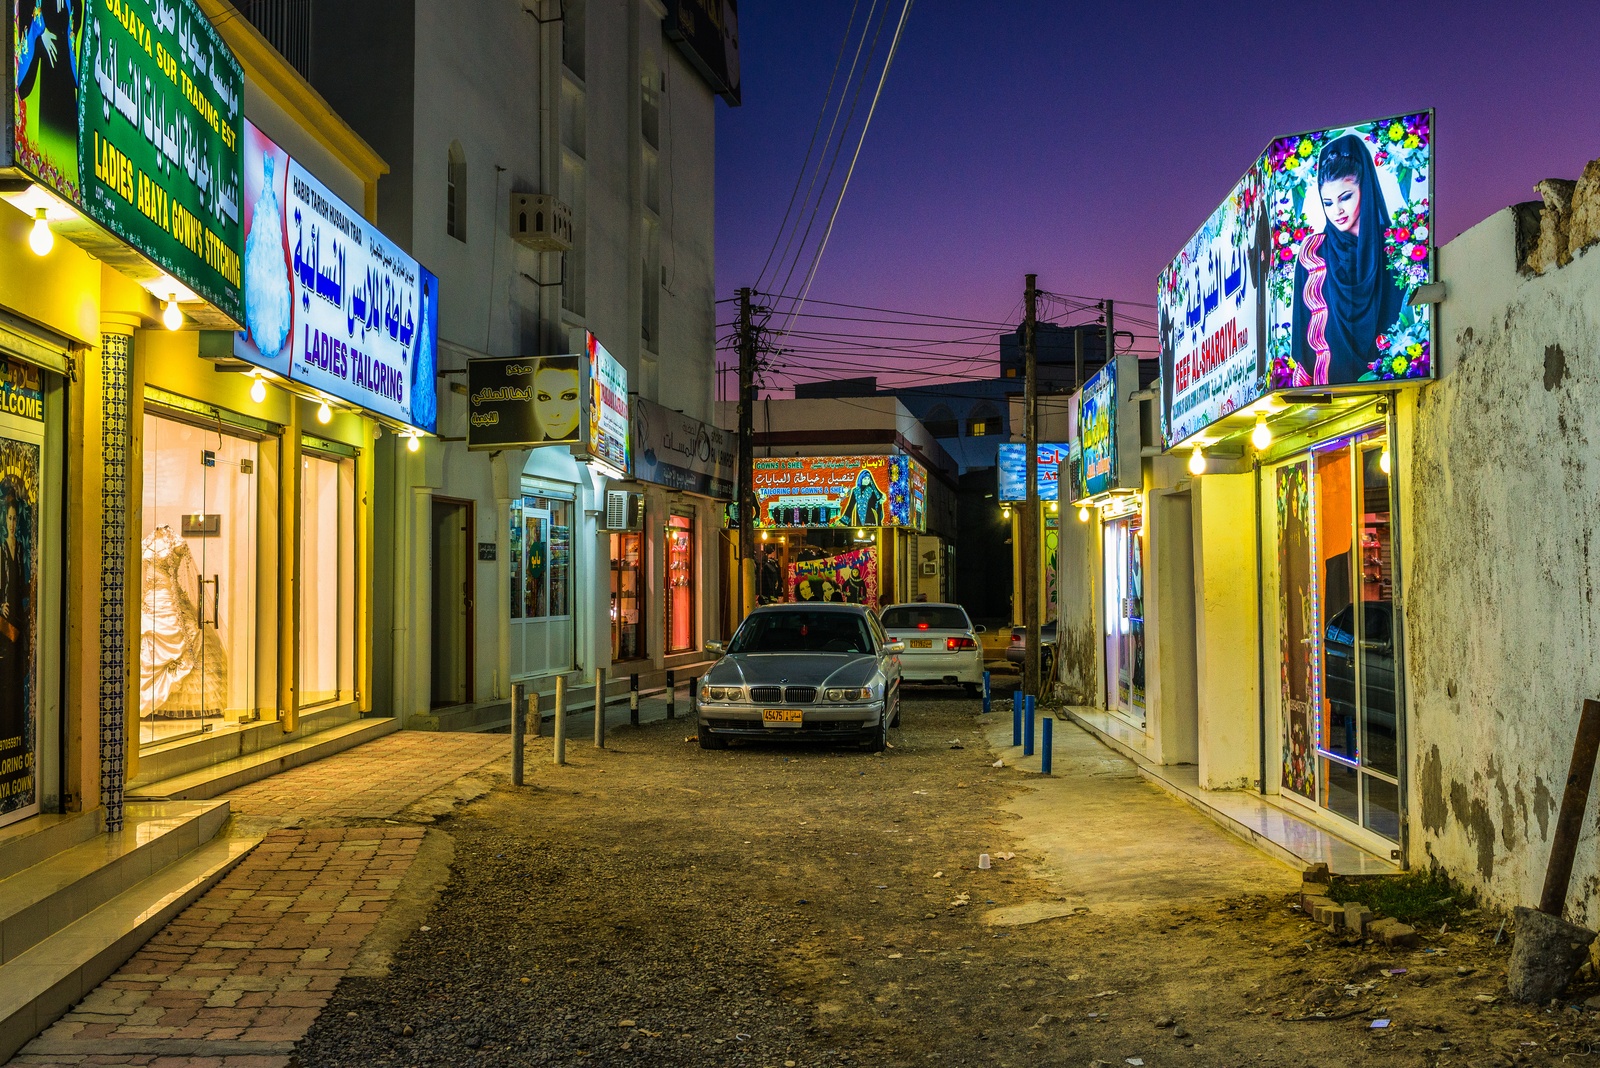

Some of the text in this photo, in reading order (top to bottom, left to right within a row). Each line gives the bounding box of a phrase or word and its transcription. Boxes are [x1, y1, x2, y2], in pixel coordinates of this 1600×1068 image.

[93, 16, 143, 133] النسائية
[156, 41, 178, 86] SUR
[180, 69, 219, 134] TRADING
[94, 130, 134, 205] LADIES
[137, 168, 170, 233] ABAYA
[171, 197, 203, 259] GOWN'S
[205, 226, 241, 290] STITCHING
[214, 152, 239, 227] تفصيل
[293, 175, 310, 206] HABIB
[310, 189, 329, 221] TARISH
[329, 203, 350, 237] HUSSAIN
[293, 205, 415, 366] خياطة الملابس النسائية
[1184, 247, 1223, 346] الشرقية
[304, 323, 403, 404] LADIES TAILORING
[1175, 353, 1191, 396] REEF
[755, 472, 855, 486] تفصيل وخياطة العبايات
[756, 461, 780, 470] GOWNS
[780, 461, 786, 469] &
[760, 487, 791, 496] TAILORING
[791, 487, 800, 495] OF
[800, 486, 823, 495] GOWN'S
[823, 486, 829, 494] &
[861, 458, 885, 469] الايمان
[765, 710, 783, 721] 45475
